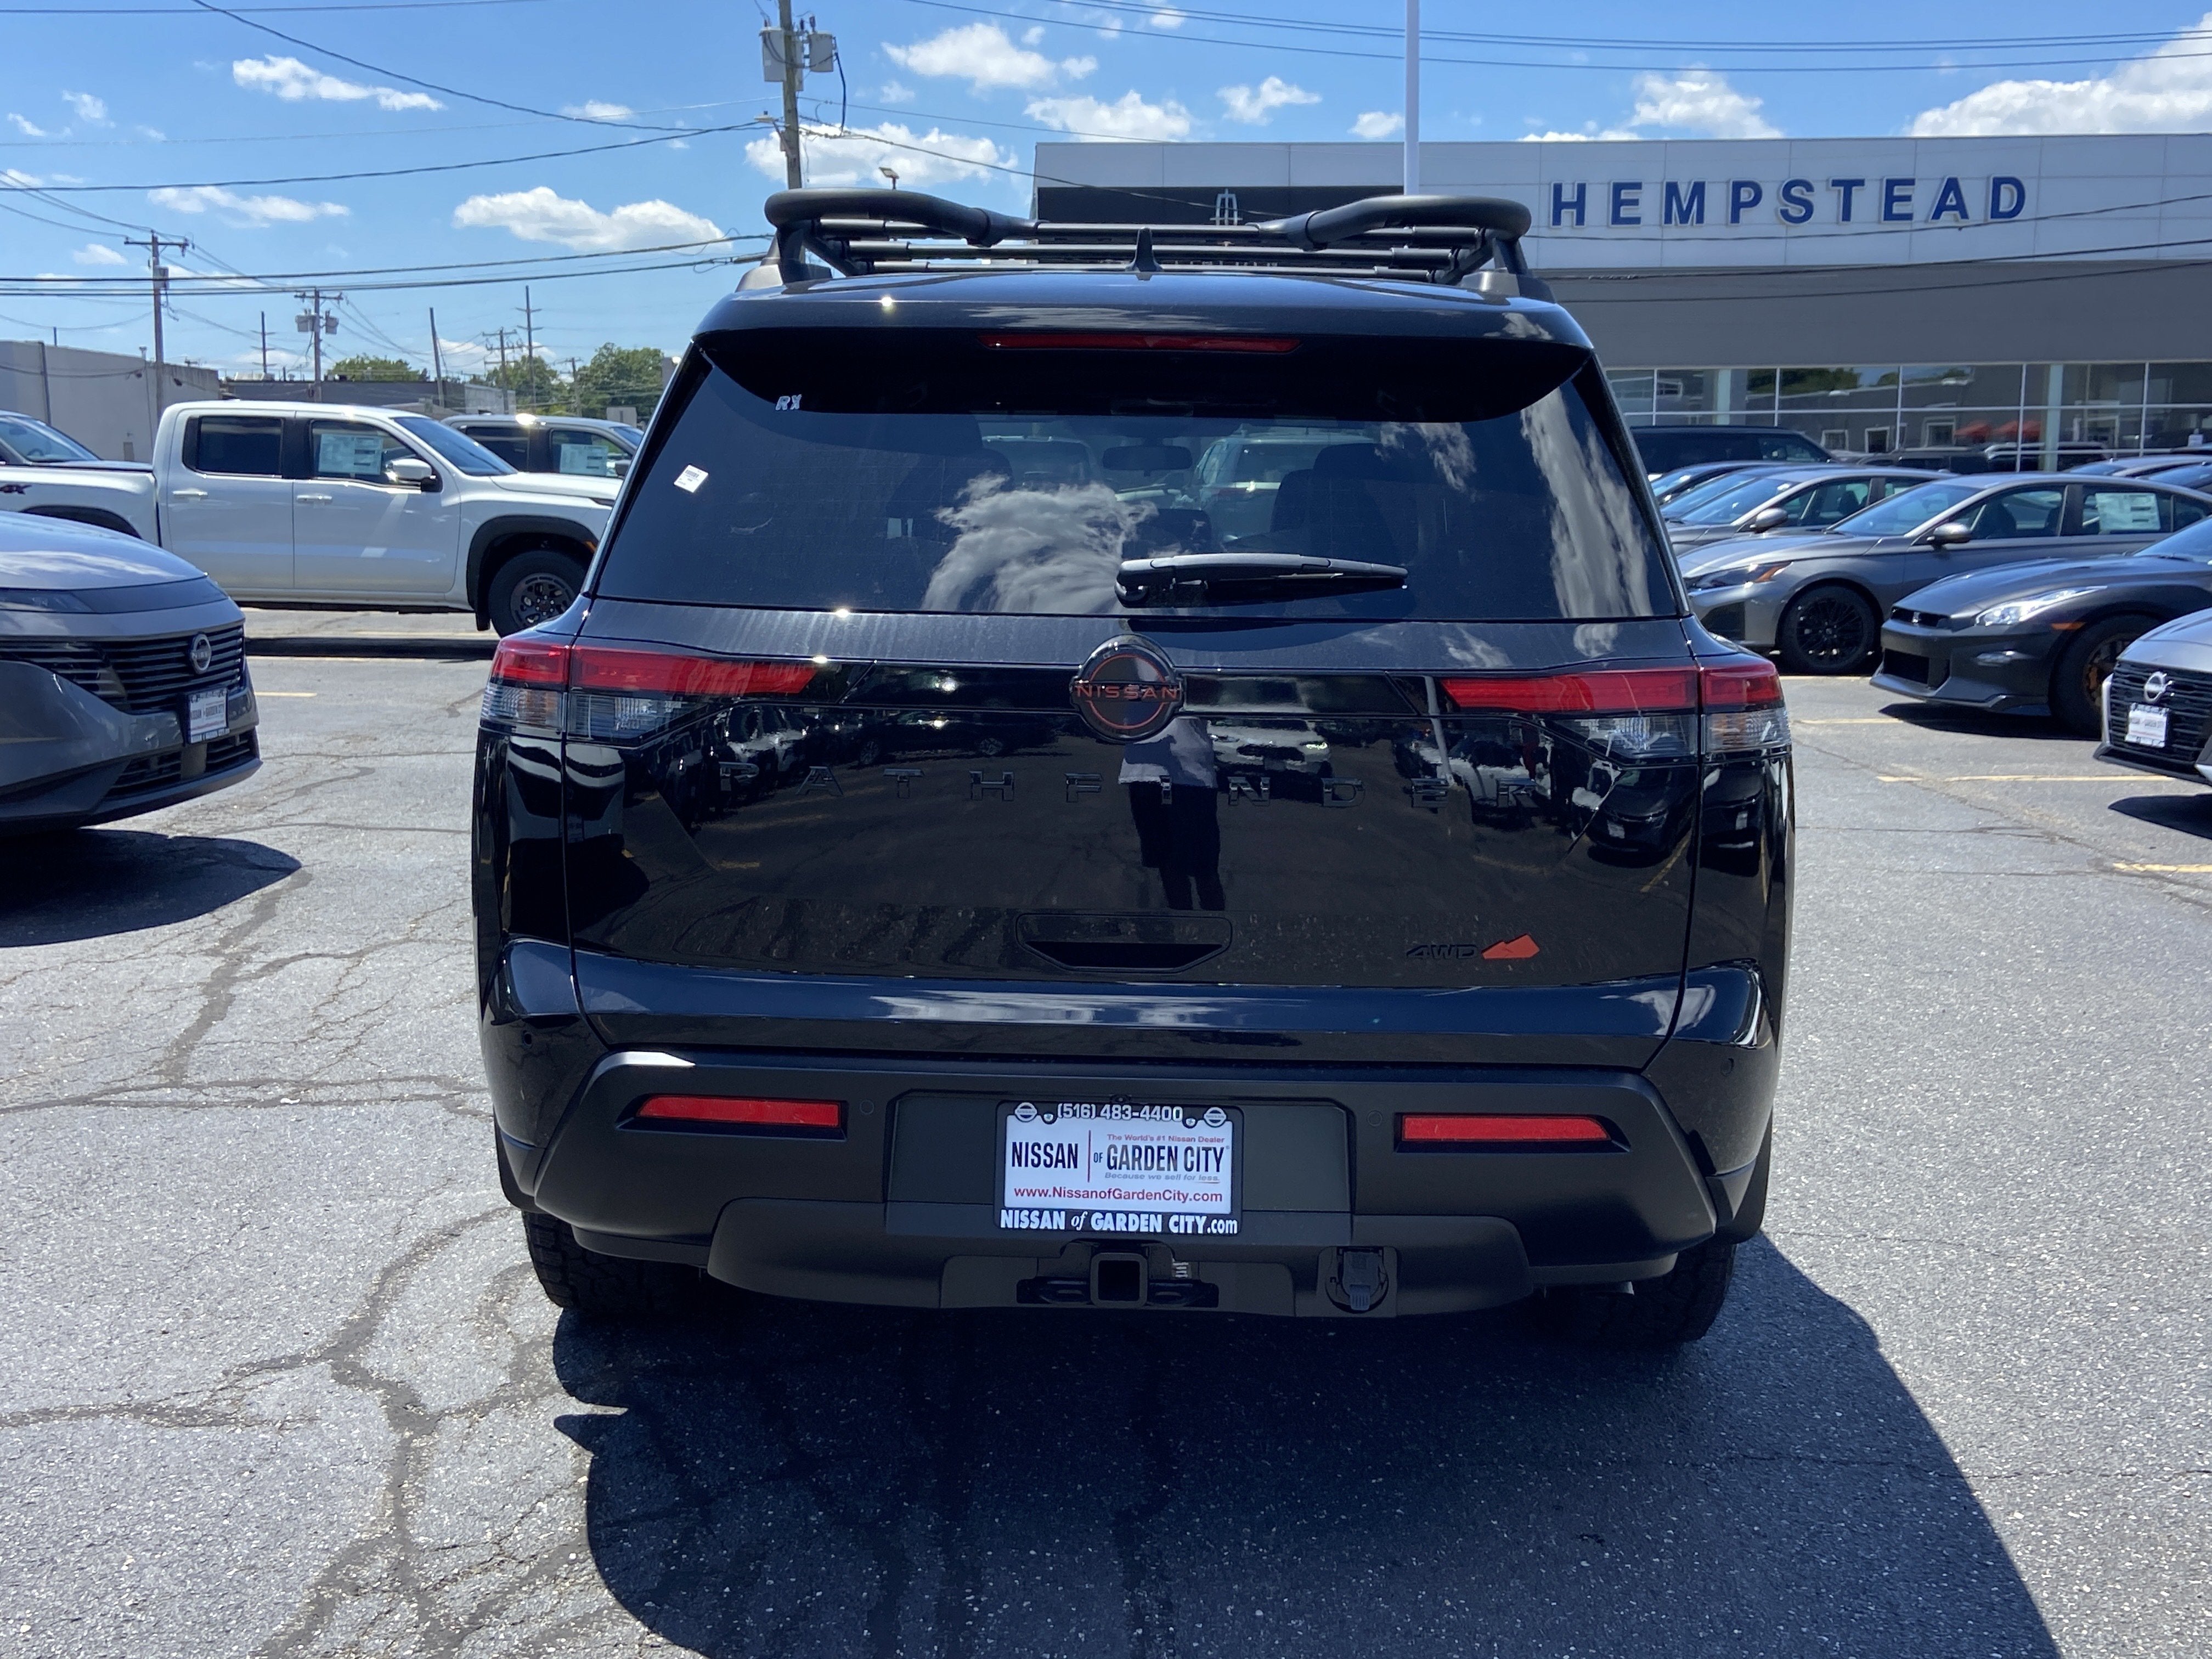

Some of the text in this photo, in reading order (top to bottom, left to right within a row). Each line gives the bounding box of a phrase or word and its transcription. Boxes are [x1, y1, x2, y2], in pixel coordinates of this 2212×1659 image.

[1552, 177, 2027, 226] HEMPSTEAD
[1076, 685, 1177, 699] NISSAN
[719, 761, 1537, 809] PATHFINDER
[1406, 944, 1479, 959] 4WD
[1058, 1103, 1183, 1121] (516) 483-4400
[1012, 1142, 1078, 1169] NISSAN
[1093, 1144, 1224, 1172] OF GARDEN CITY
[1165, 1173, 1181, 1181] sell
[1014, 1186, 1222, 1203] www.NissanofGardenCity.com
[1000, 1210, 1238, 1234] NISSAN of GARDEN CITY.com
